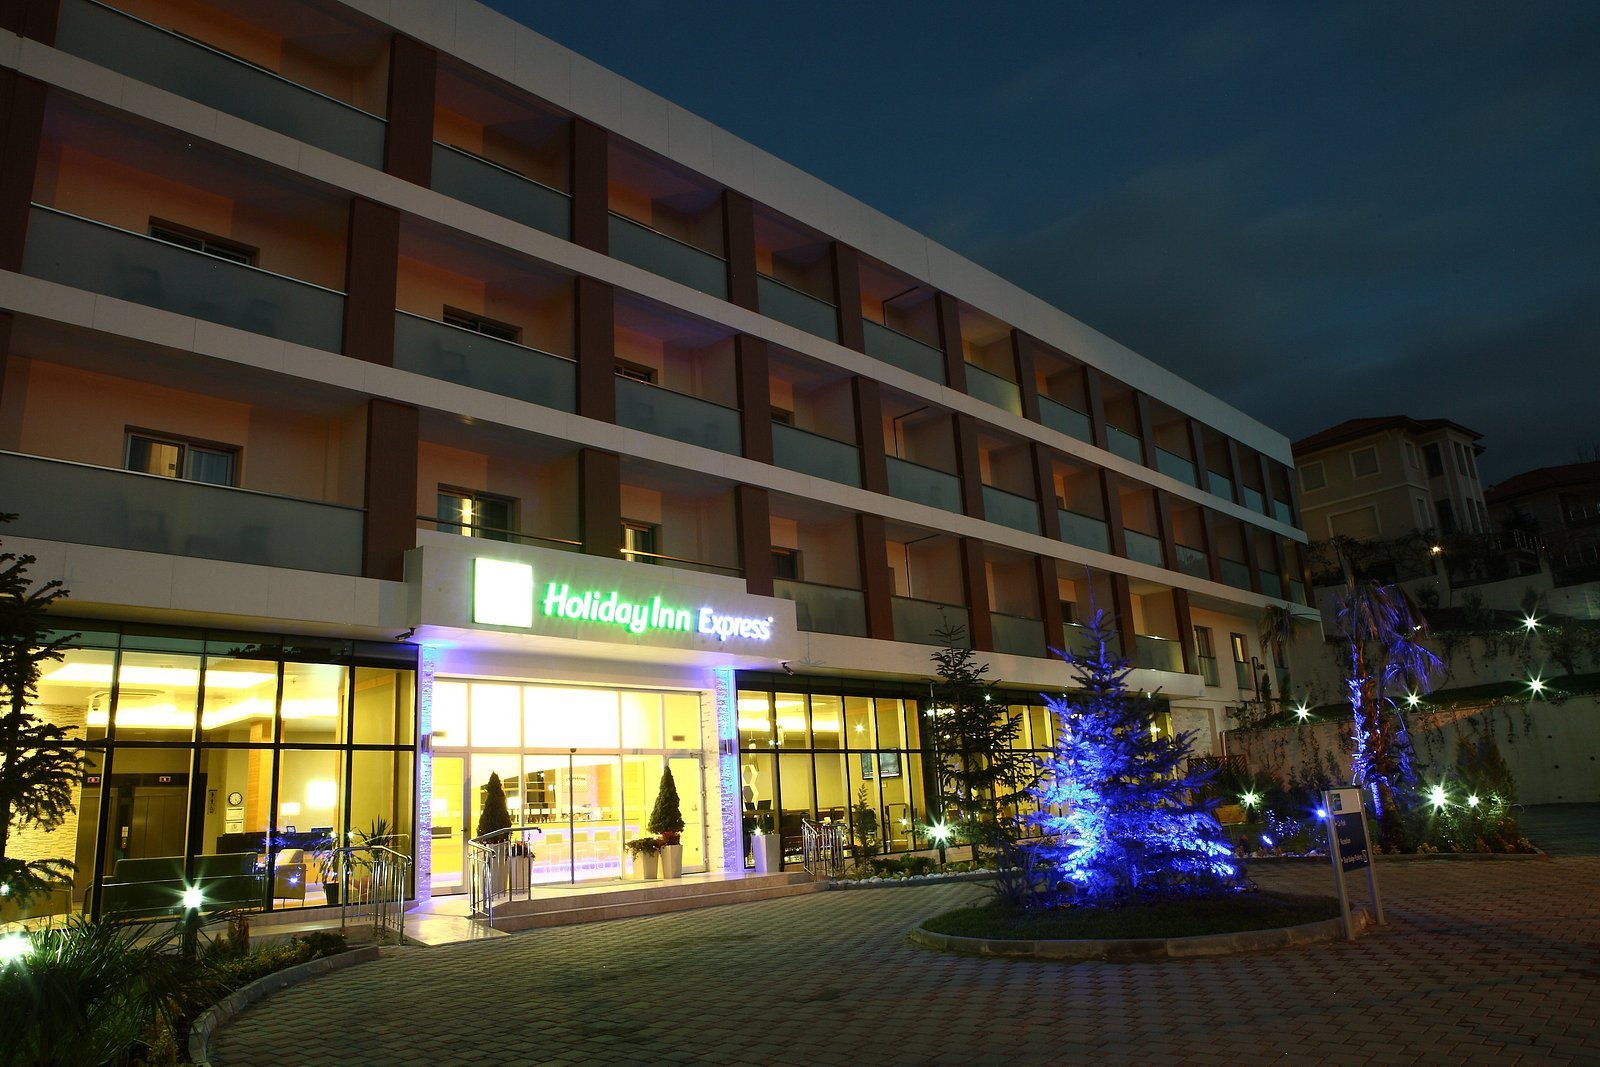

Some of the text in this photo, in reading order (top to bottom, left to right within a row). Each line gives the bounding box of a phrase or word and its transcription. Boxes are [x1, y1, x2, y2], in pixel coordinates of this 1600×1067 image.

[543, 582, 771, 641] Holiday Inn Express
